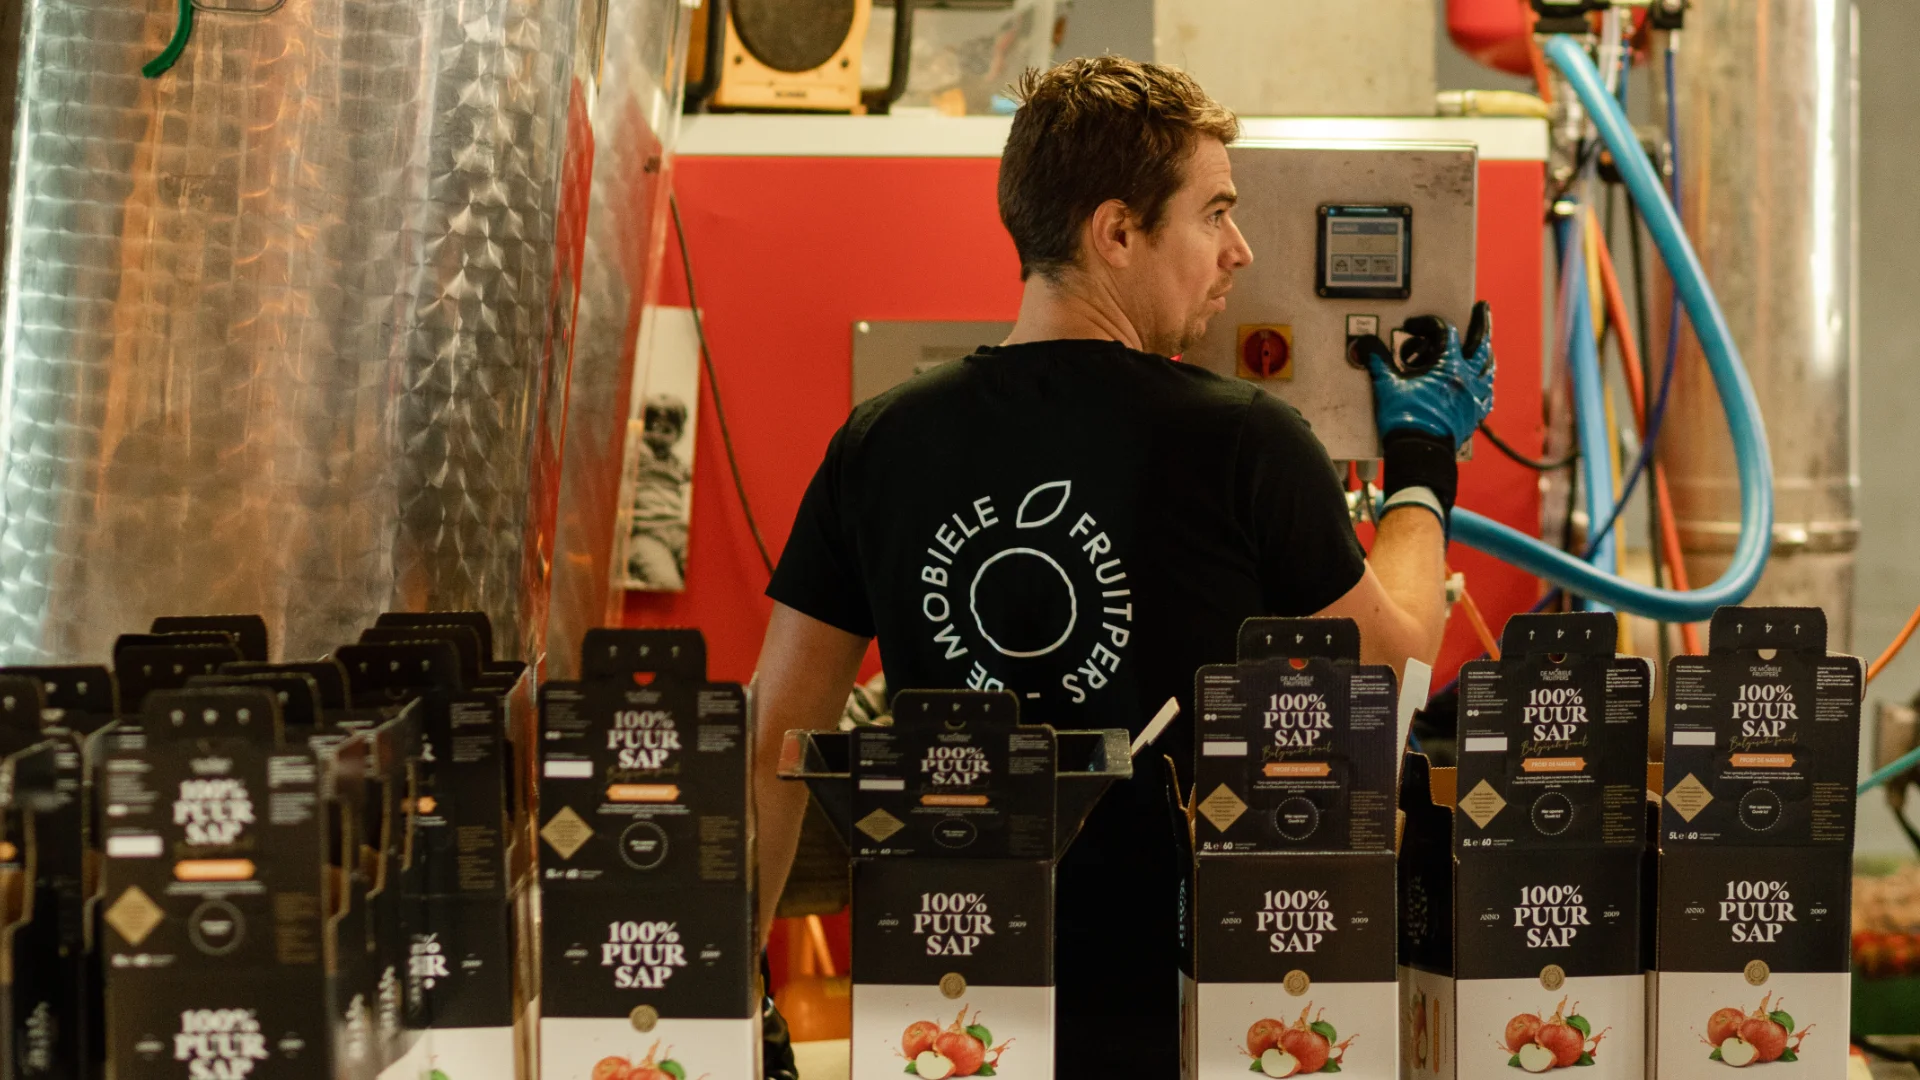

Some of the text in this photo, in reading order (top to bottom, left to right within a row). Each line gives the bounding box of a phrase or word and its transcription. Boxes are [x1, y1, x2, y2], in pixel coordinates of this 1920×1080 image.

[921, 495, 999, 660] MOBIELE
[1062, 512, 1133, 704] FRUITPERS
[1270, 693, 1327, 711] 100%
[1529, 688, 1583, 706] 100%
[1738, 684, 1793, 702] 100%
[614, 711, 675, 729] 100%
[1263, 711, 1334, 729] PUUR
[1522, 706, 1589, 724] PUUR
[1731, 702, 1799, 720] PUUR
[1274, 729, 1320, 747] SAP
[1533, 723, 1577, 742] SAP
[1741, 720, 1787, 737] SAP
[606, 729, 682, 750] PUUR
[618, 748, 669, 769] SAP
[927, 746, 985, 760] 100%
[920, 759, 992, 773] PUUR
[931, 771, 979, 785] SAP
[1223, 841, 1233, 850] 60
[1481, 838, 1492, 846] 60
[1688, 831, 1698, 840] 60
[1263, 890, 1330, 910] 100%
[1520, 885, 1583, 906] 100%
[1725, 880, 1790, 901] 100%
[920, 892, 988, 913] 100%
[1718, 901, 1798, 922] PUUR
[913, 913, 996, 935] PUUR
[1221, 917, 1242, 925] ANNO
[1256, 911, 1338, 932] PUUR
[1513, 906, 1592, 927] PUUR
[608, 921, 680, 943] 100%
[1526, 927, 1577, 948] SAP
[1731, 922, 1783, 943] SAP
[926, 934, 981, 956] SAP
[1270, 932, 1323, 953] SAP
[601, 943, 688, 966] PUUR
[615, 965, 673, 988] SAP
